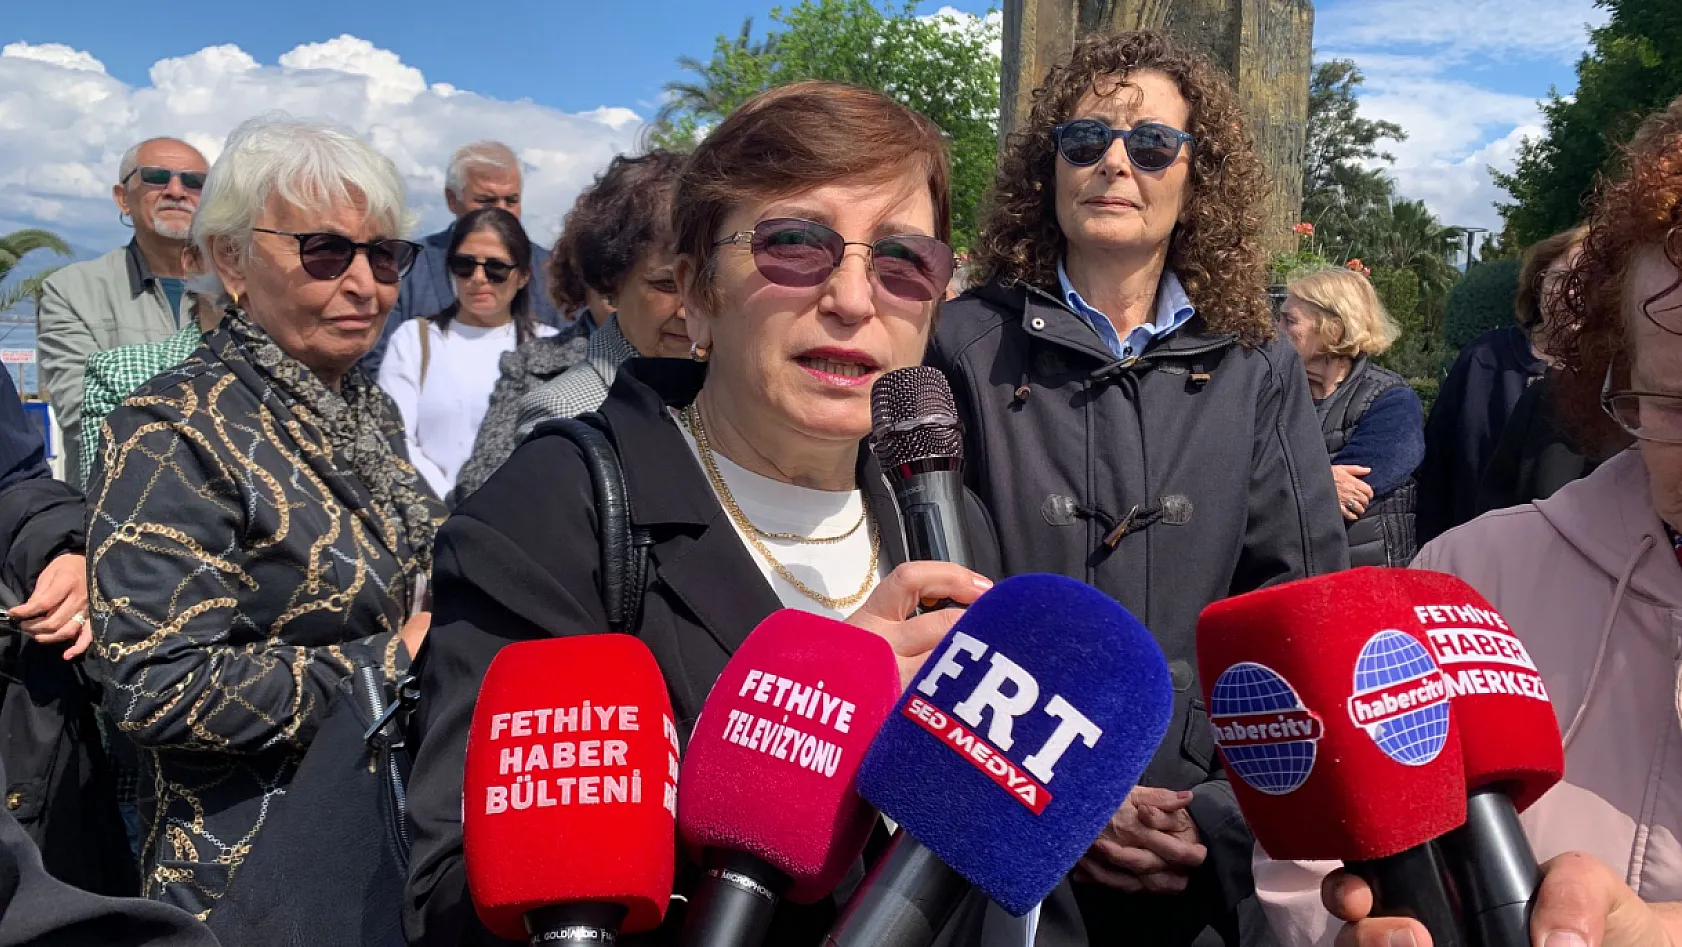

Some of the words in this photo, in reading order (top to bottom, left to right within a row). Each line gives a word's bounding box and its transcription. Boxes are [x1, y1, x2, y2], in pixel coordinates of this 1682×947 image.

[1413, 603, 1509, 631] FETHİYE
[1431, 633, 1526, 663] HABER
[489, 699, 640, 740] FETHİYE
[739, 669, 856, 734] FETHİYE
[916, 631, 1103, 785] FRT
[499, 739, 628, 775] HABER
[722, 708, 843, 778] TELEVİZYONU
[908, 699, 948, 730] SED
[947, 728, 1037, 806] MEDYA
[485, 768, 642, 815] BÜLTENİ
